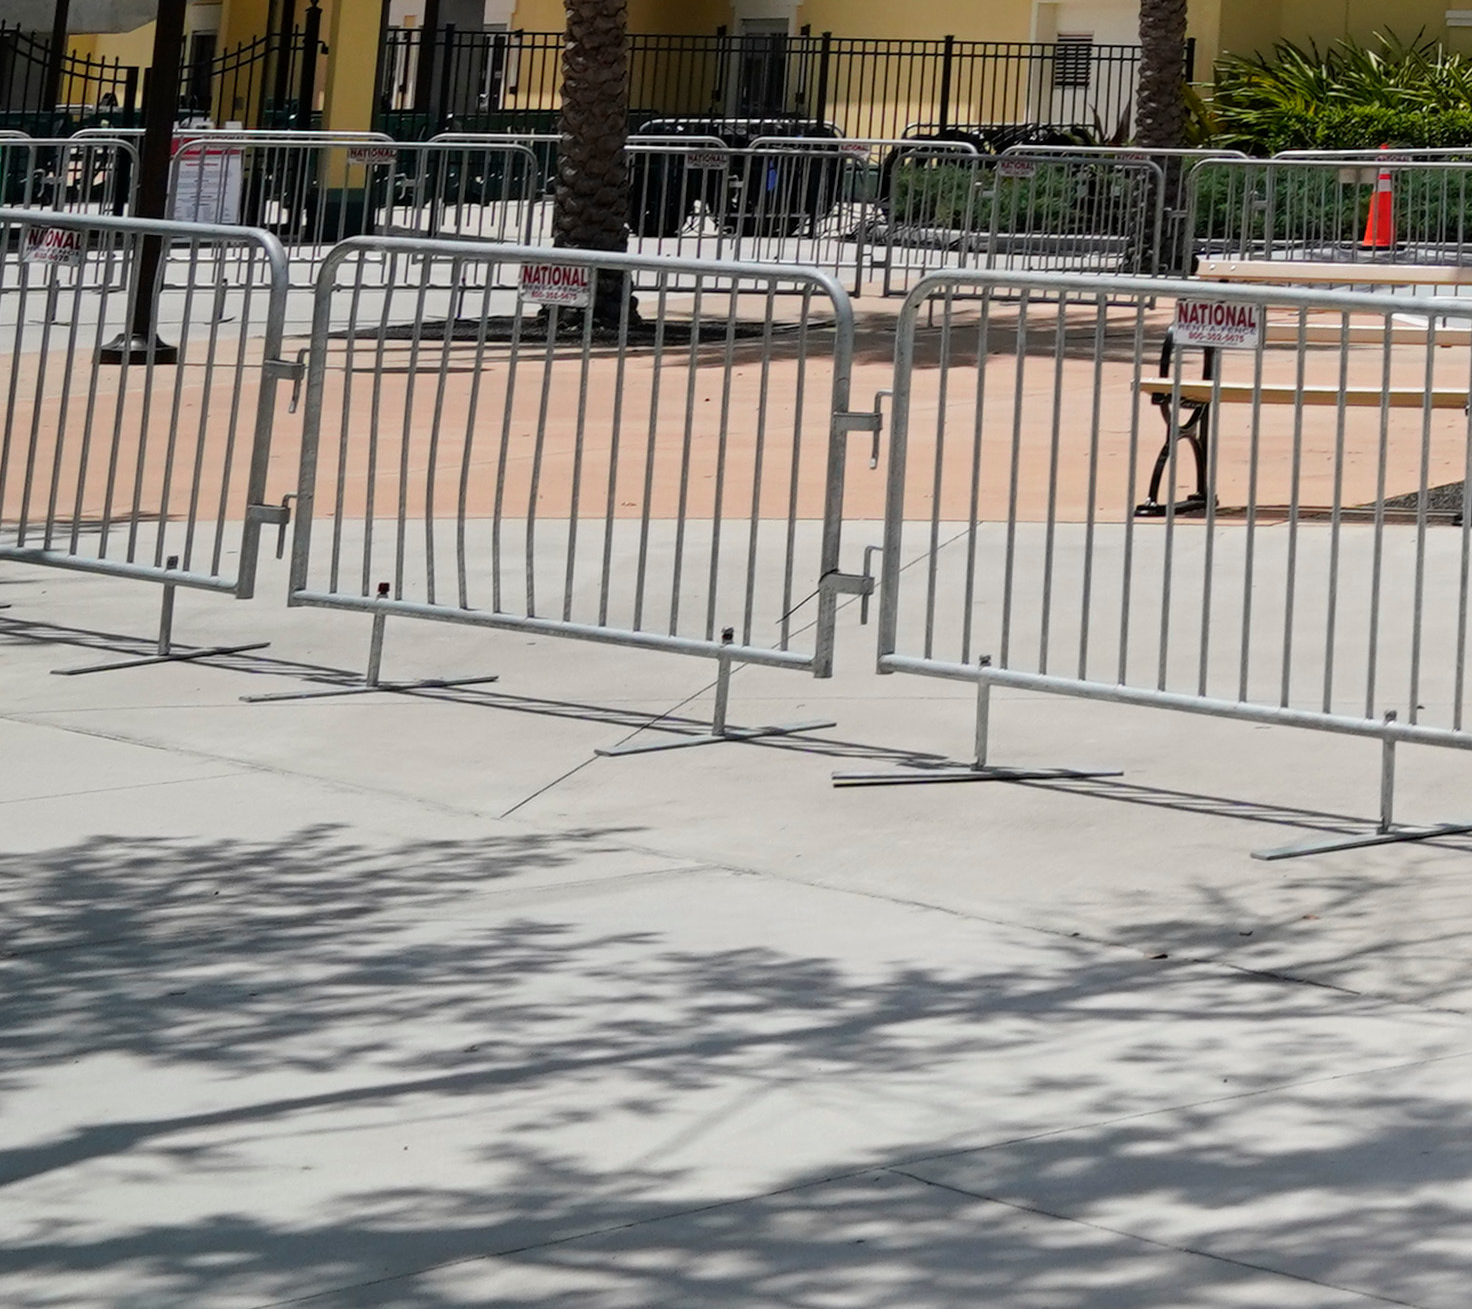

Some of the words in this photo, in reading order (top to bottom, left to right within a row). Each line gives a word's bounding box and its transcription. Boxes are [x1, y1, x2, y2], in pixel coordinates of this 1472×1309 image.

[349, 148, 396, 158] NATIONAL
[522, 265, 588, 287] NATIONAL
[1178, 302, 1256, 328] NATIONAL
[1178, 324, 1257, 335] RENT-A-FENCE
